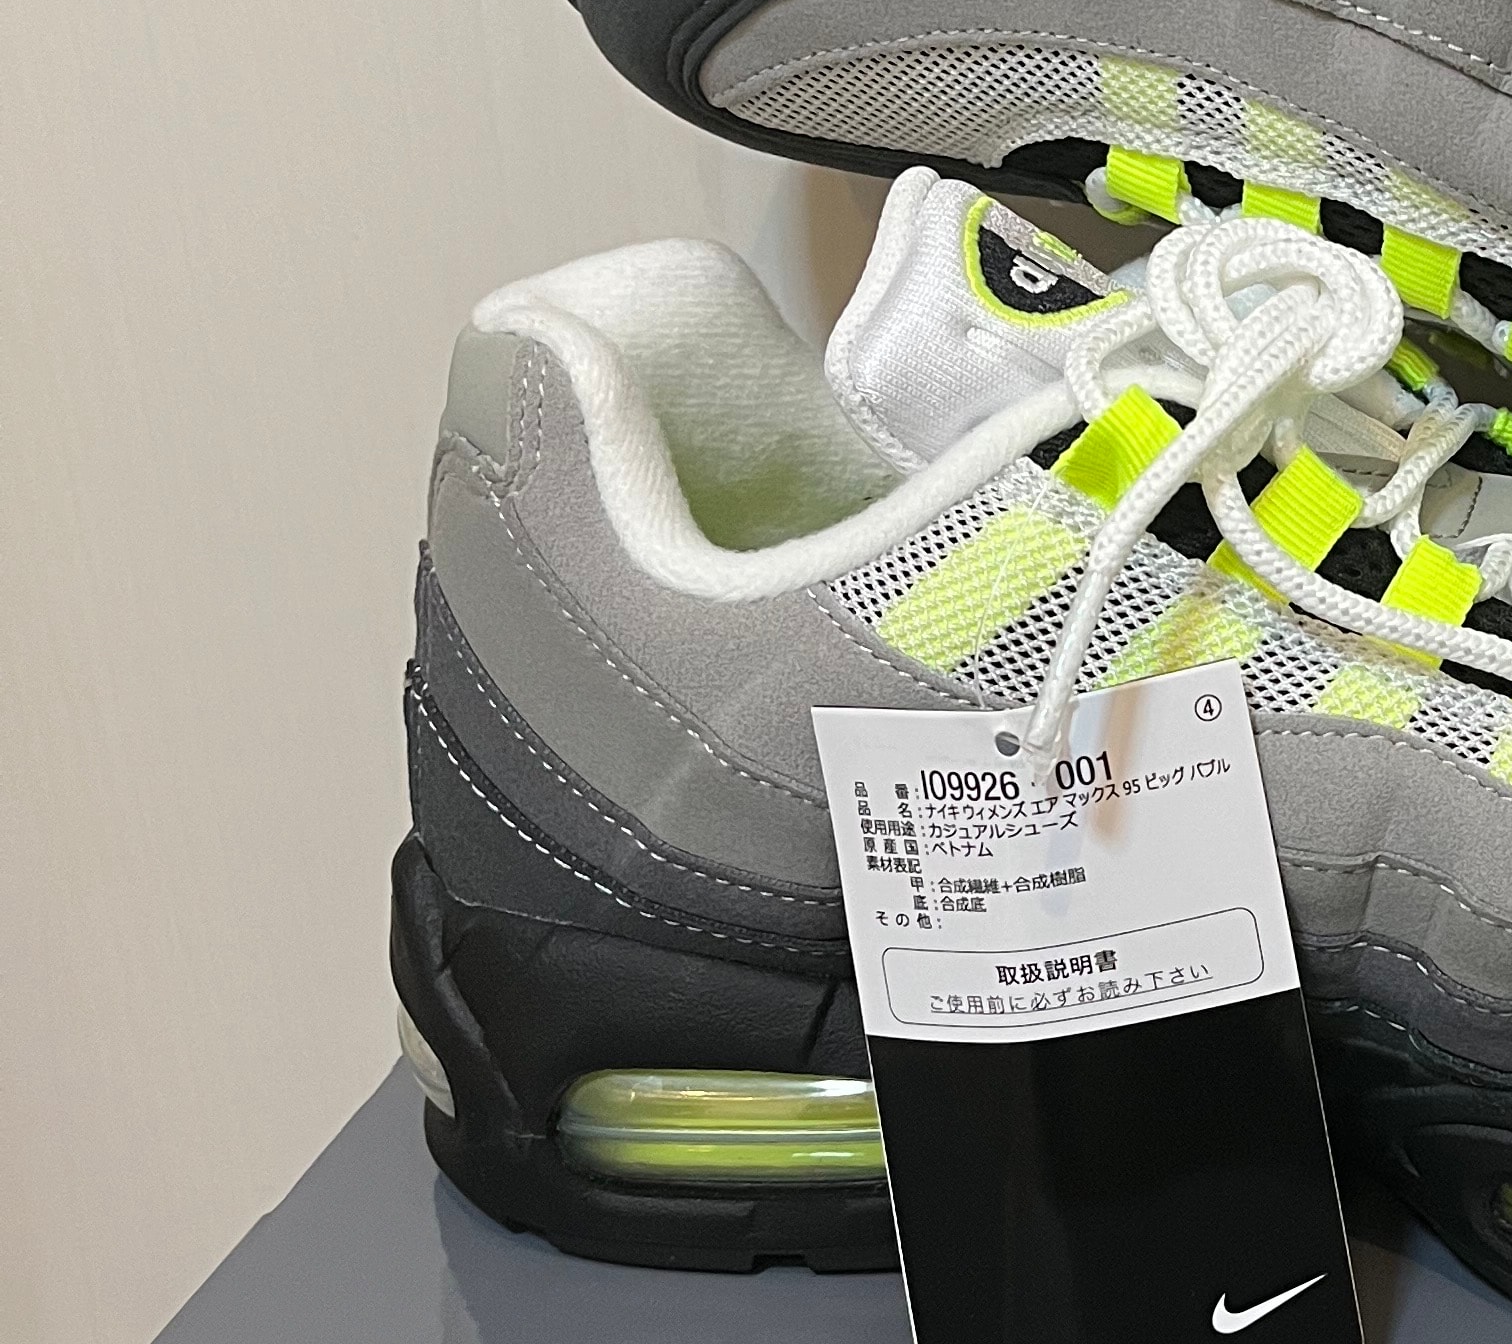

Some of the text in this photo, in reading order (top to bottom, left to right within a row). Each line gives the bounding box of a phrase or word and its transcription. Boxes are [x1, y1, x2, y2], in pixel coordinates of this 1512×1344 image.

[1055, 750, 1114, 791] 001
[1122, 778, 1141, 796] 95
[995, 950, 1119, 987] 取扱説明書
